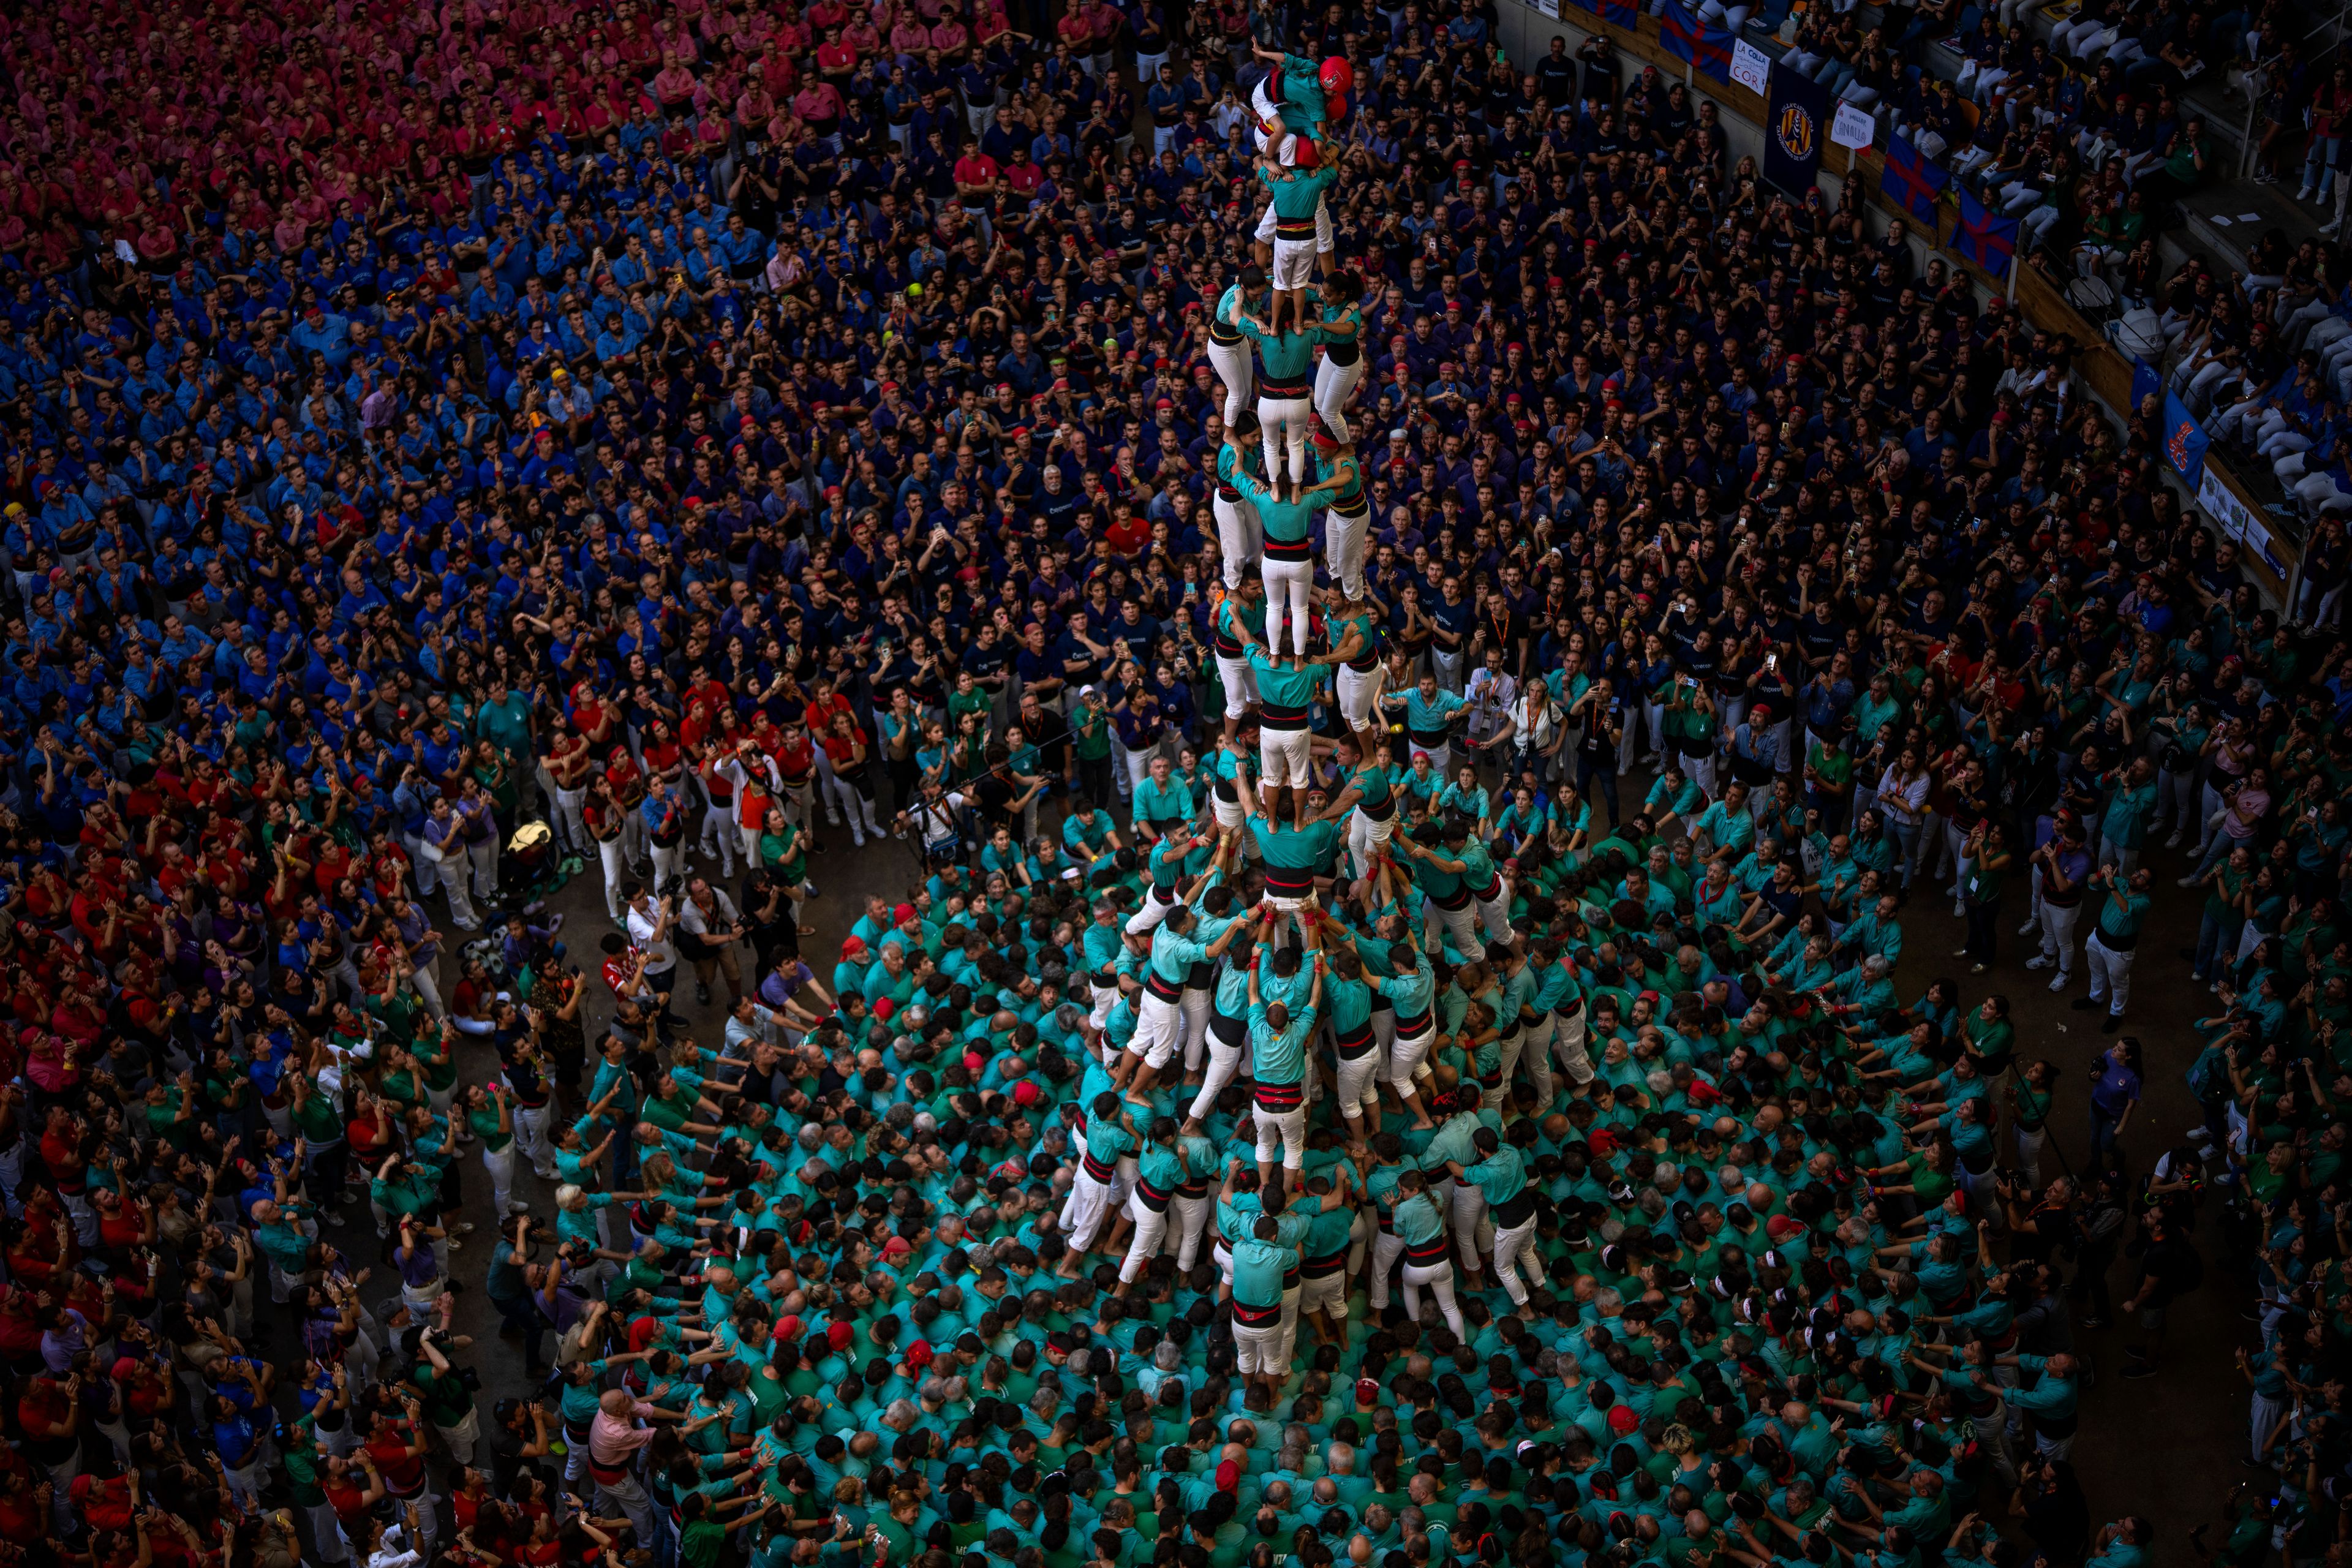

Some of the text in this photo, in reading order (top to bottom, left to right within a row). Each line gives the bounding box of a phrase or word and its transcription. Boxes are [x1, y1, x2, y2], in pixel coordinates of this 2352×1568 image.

[1737, 42, 1766, 64] LA COLLA
[1734, 66, 1758, 89] COR
[1834, 119, 1867, 144] CANALLA
